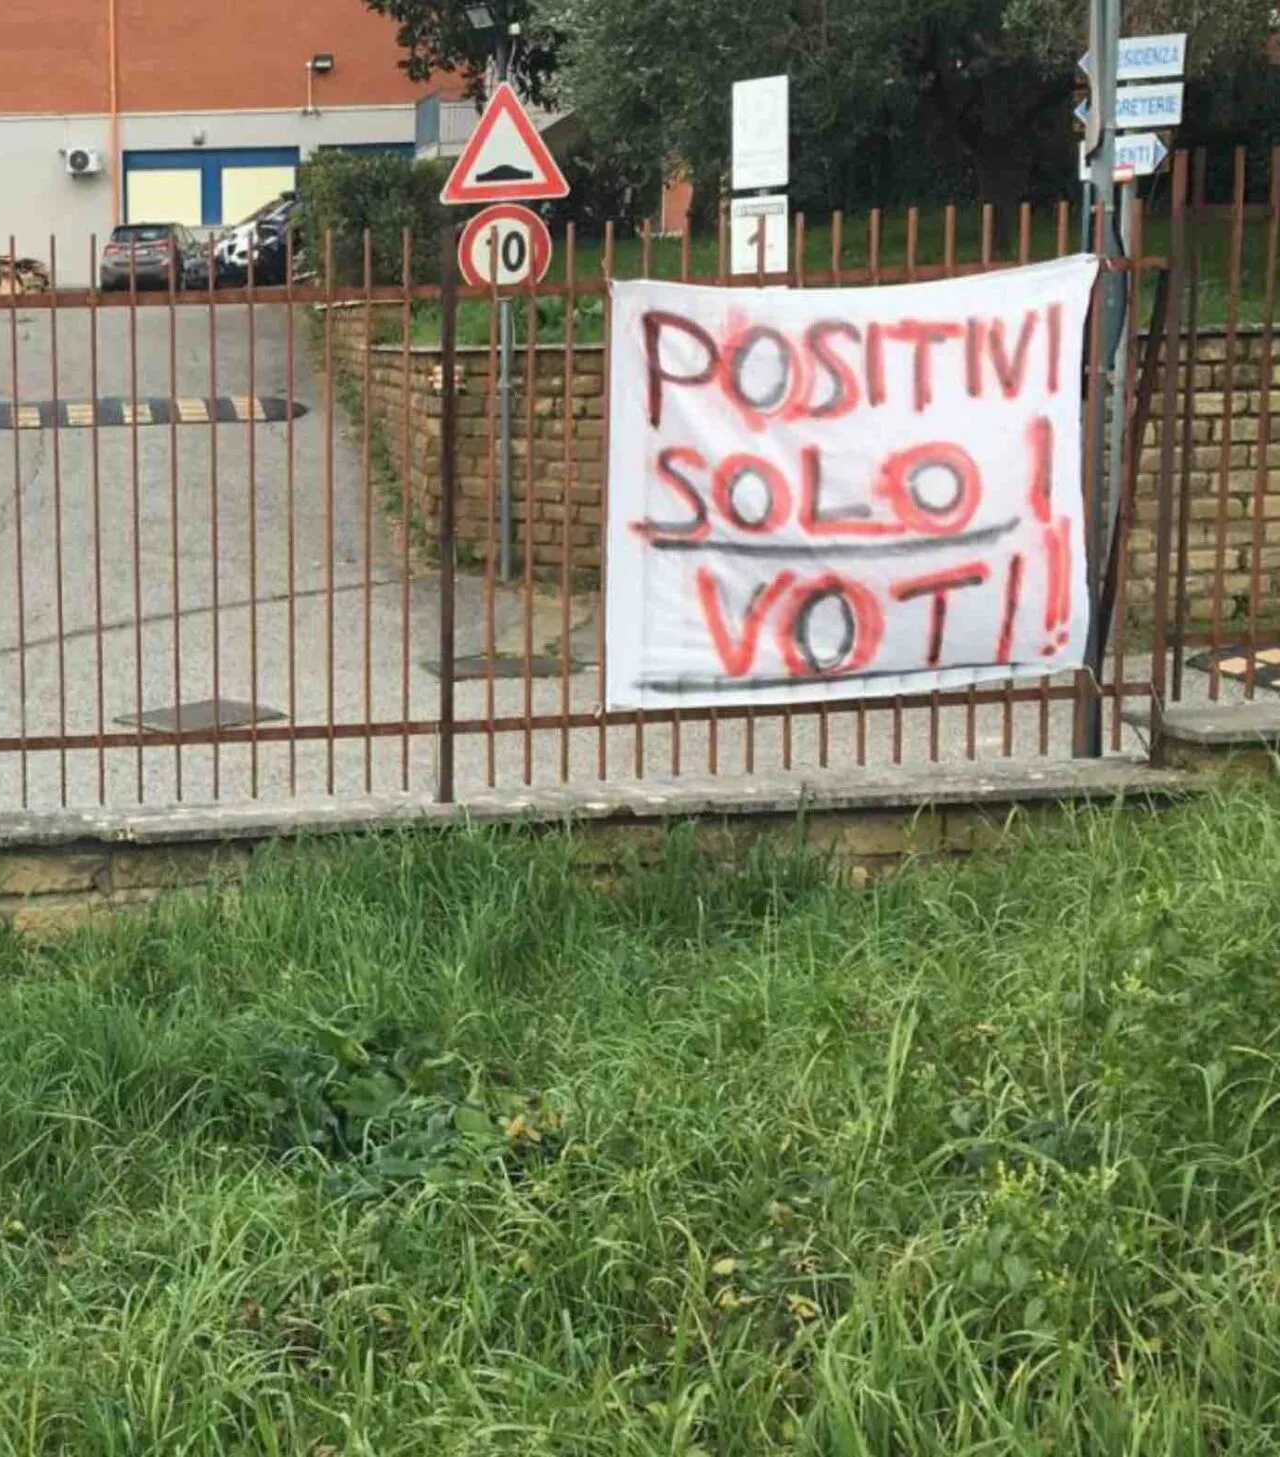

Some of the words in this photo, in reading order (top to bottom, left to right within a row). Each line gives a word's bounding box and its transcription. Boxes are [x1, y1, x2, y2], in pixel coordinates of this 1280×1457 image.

[1119, 144, 1151, 160] ENTI
[640, 303, 1062, 430] POSITIVI
[630, 441, 982, 542] SOLO
